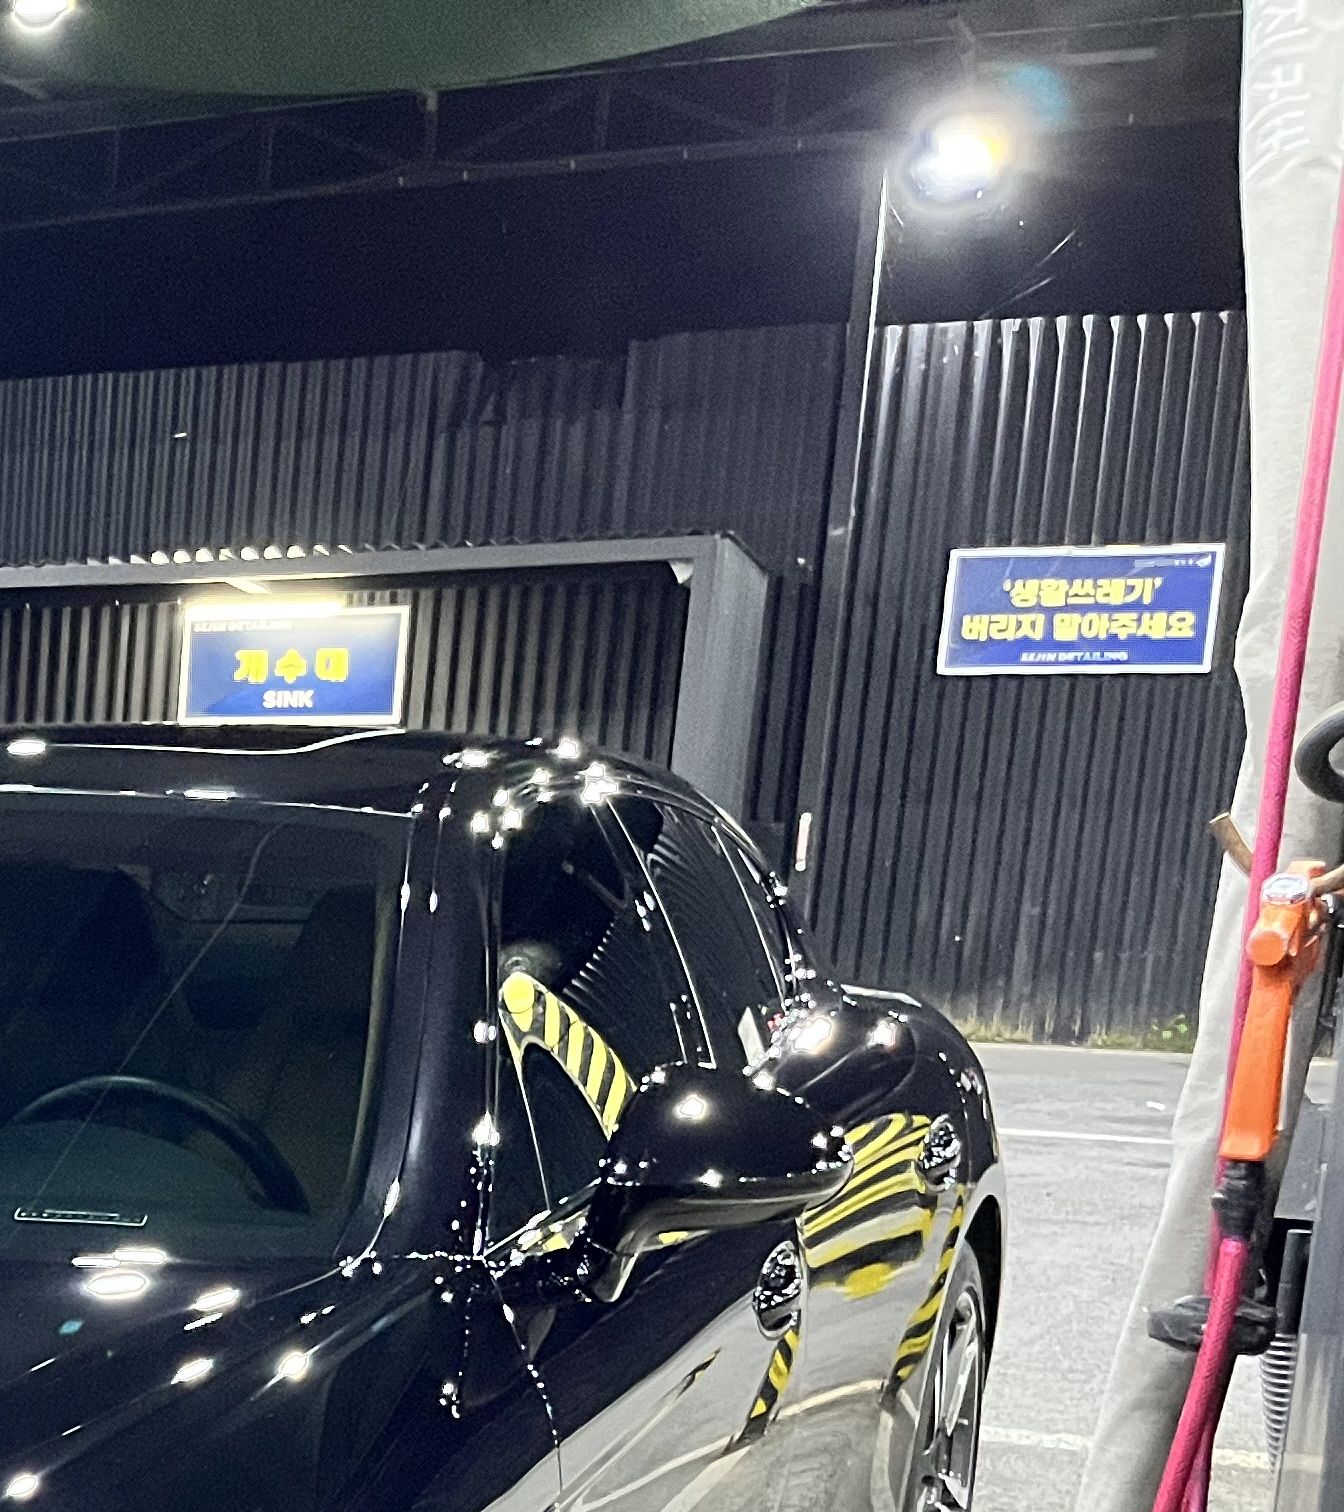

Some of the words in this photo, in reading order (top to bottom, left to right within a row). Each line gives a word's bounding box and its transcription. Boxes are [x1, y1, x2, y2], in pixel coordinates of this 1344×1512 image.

[962, 613, 1045, 641] 버리지
[1052, 611, 1196, 640] 말아주세요
[263, 690, 314, 708] SINK
